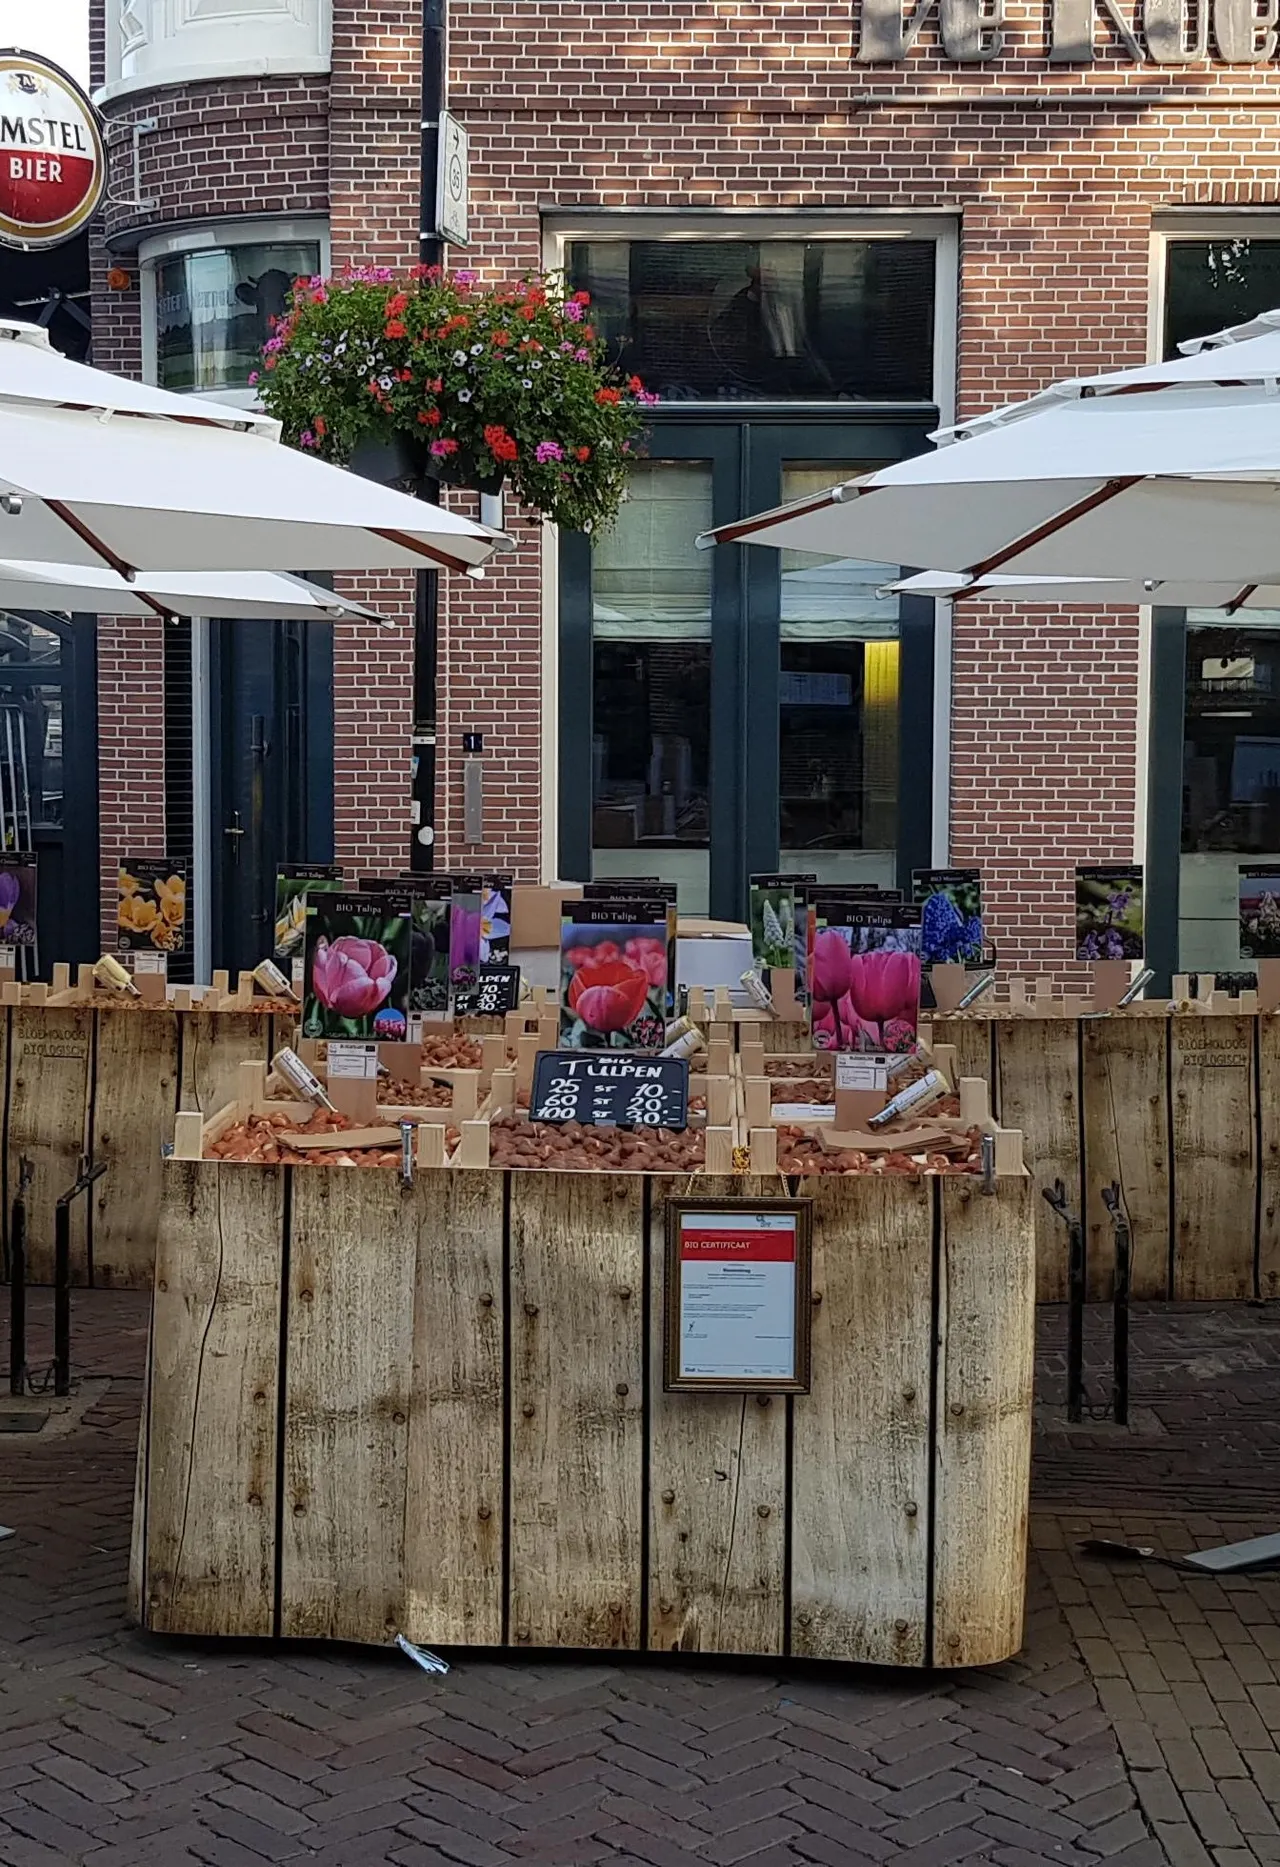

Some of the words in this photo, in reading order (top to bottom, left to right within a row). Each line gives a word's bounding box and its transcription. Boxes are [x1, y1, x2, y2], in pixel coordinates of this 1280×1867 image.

[9, 157, 63, 183] BIER
[469, 735, 475, 749] 1
[336, 904, 353, 912] BIO
[356, 904, 382, 914] Tulipa
[591, 911, 609, 920] BIO
[611, 911, 637, 922] Tulipa
[846, 914, 864, 923] BIO
[867, 914, 893, 925] Tulipa
[559, 1058, 663, 1078] TULPEN
[548, 1078, 582, 1094] 25
[544, 1094, 578, 1106] 60
[536, 1106, 576, 1119] 100
[684, 1241, 699, 1249] BIO
[701, 1241, 751, 1249] CERTIFICAAT
